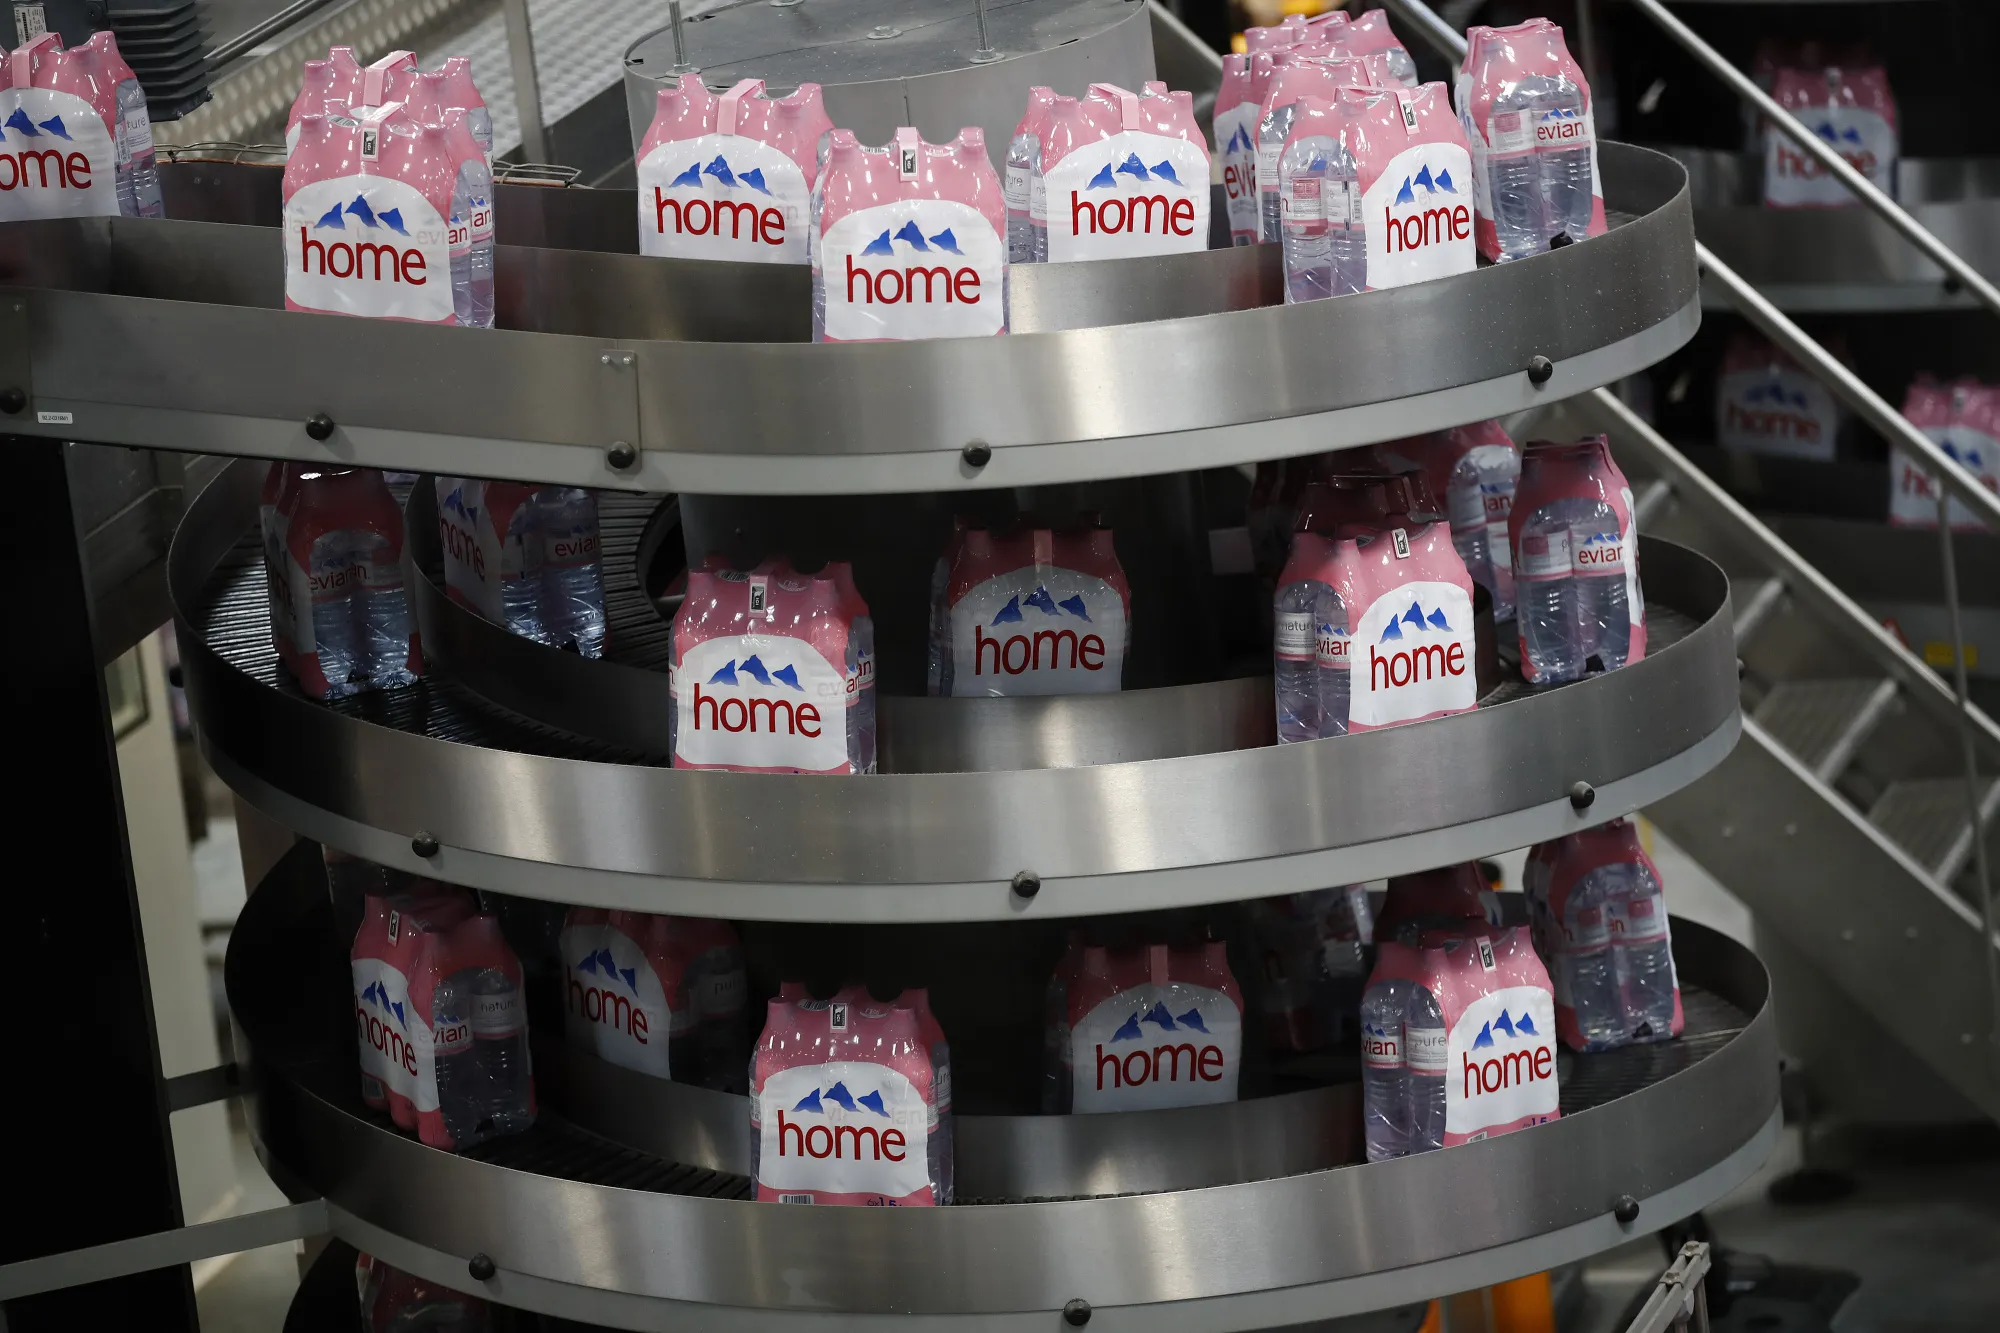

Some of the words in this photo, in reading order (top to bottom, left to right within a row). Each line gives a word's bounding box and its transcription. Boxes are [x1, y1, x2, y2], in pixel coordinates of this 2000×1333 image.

[1538, 121, 1585, 140] evian
[655, 186, 785, 245] home
[1071, 190, 1195, 237] home
[1386, 204, 1470, 254] home
[301, 226, 427, 286] home
[846, 254, 981, 304] home
[976, 624, 1106, 676] home
[1370, 641, 1465, 691] home
[694, 682, 821, 738] home
[566, 963, 649, 1045] home
[354, 994, 418, 1077] home
[1096, 1043, 1224, 1091] home
[1463, 1046, 1552, 1099] home
[777, 1109, 906, 1162] home
